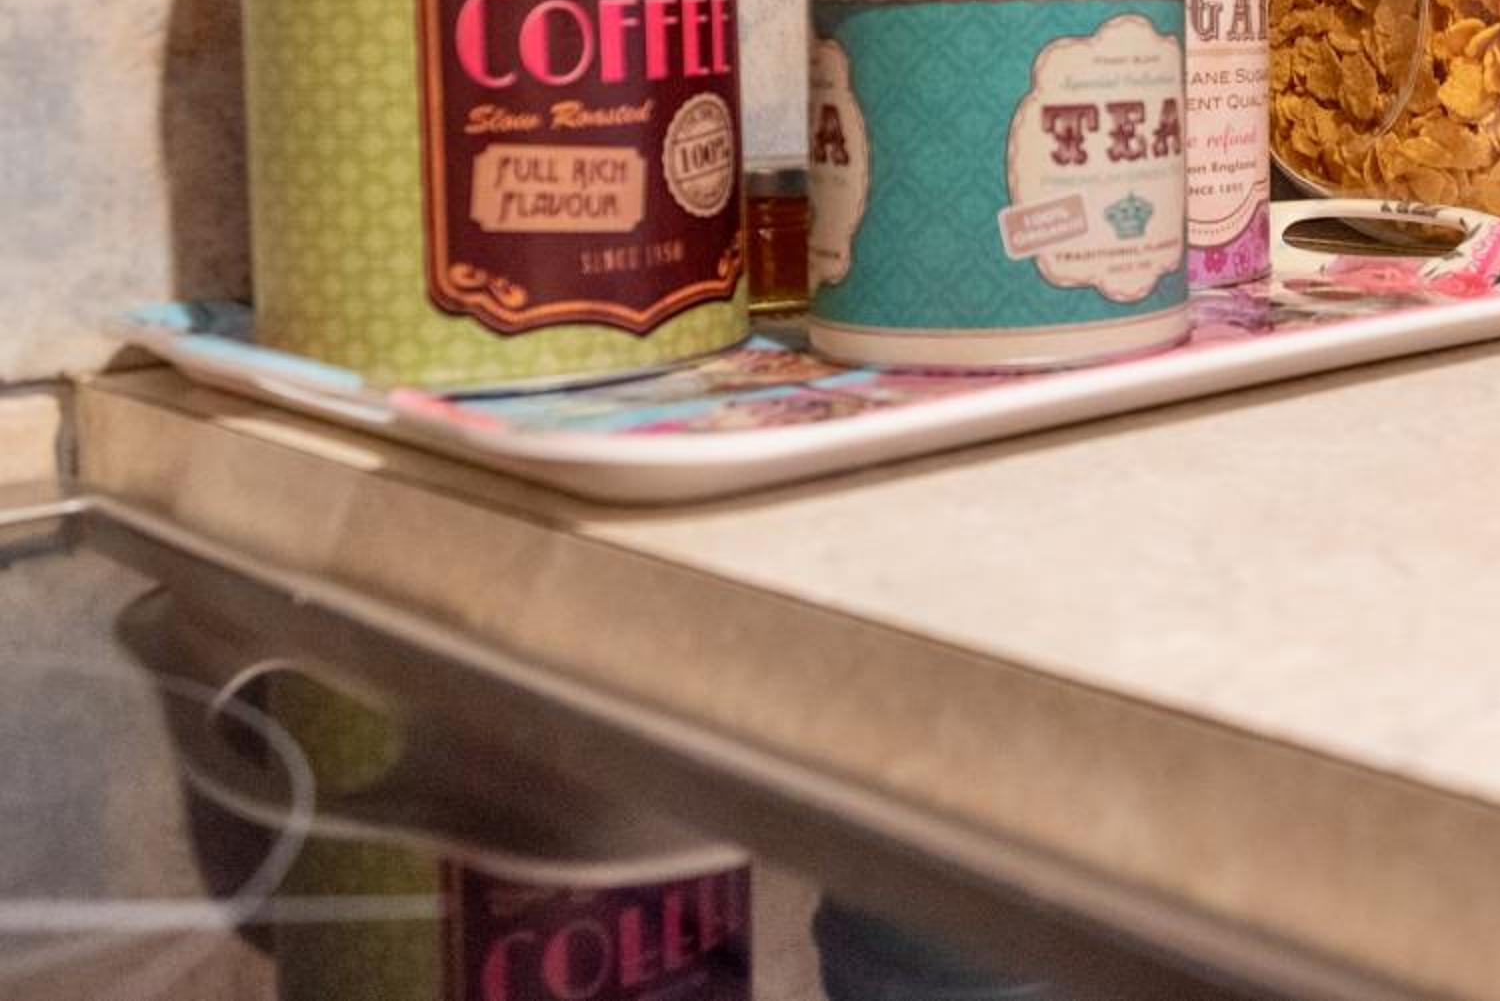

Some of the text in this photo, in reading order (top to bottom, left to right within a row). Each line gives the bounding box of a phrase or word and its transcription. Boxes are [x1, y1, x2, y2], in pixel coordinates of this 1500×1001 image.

[464, 104, 542, 134] Slow
[550, 99, 653, 130] Roasted
[1040, 97, 1182, 166] TEA
[495, 156, 627, 190] FULL RICH
[499, 190, 619, 223] FLAVOUR
